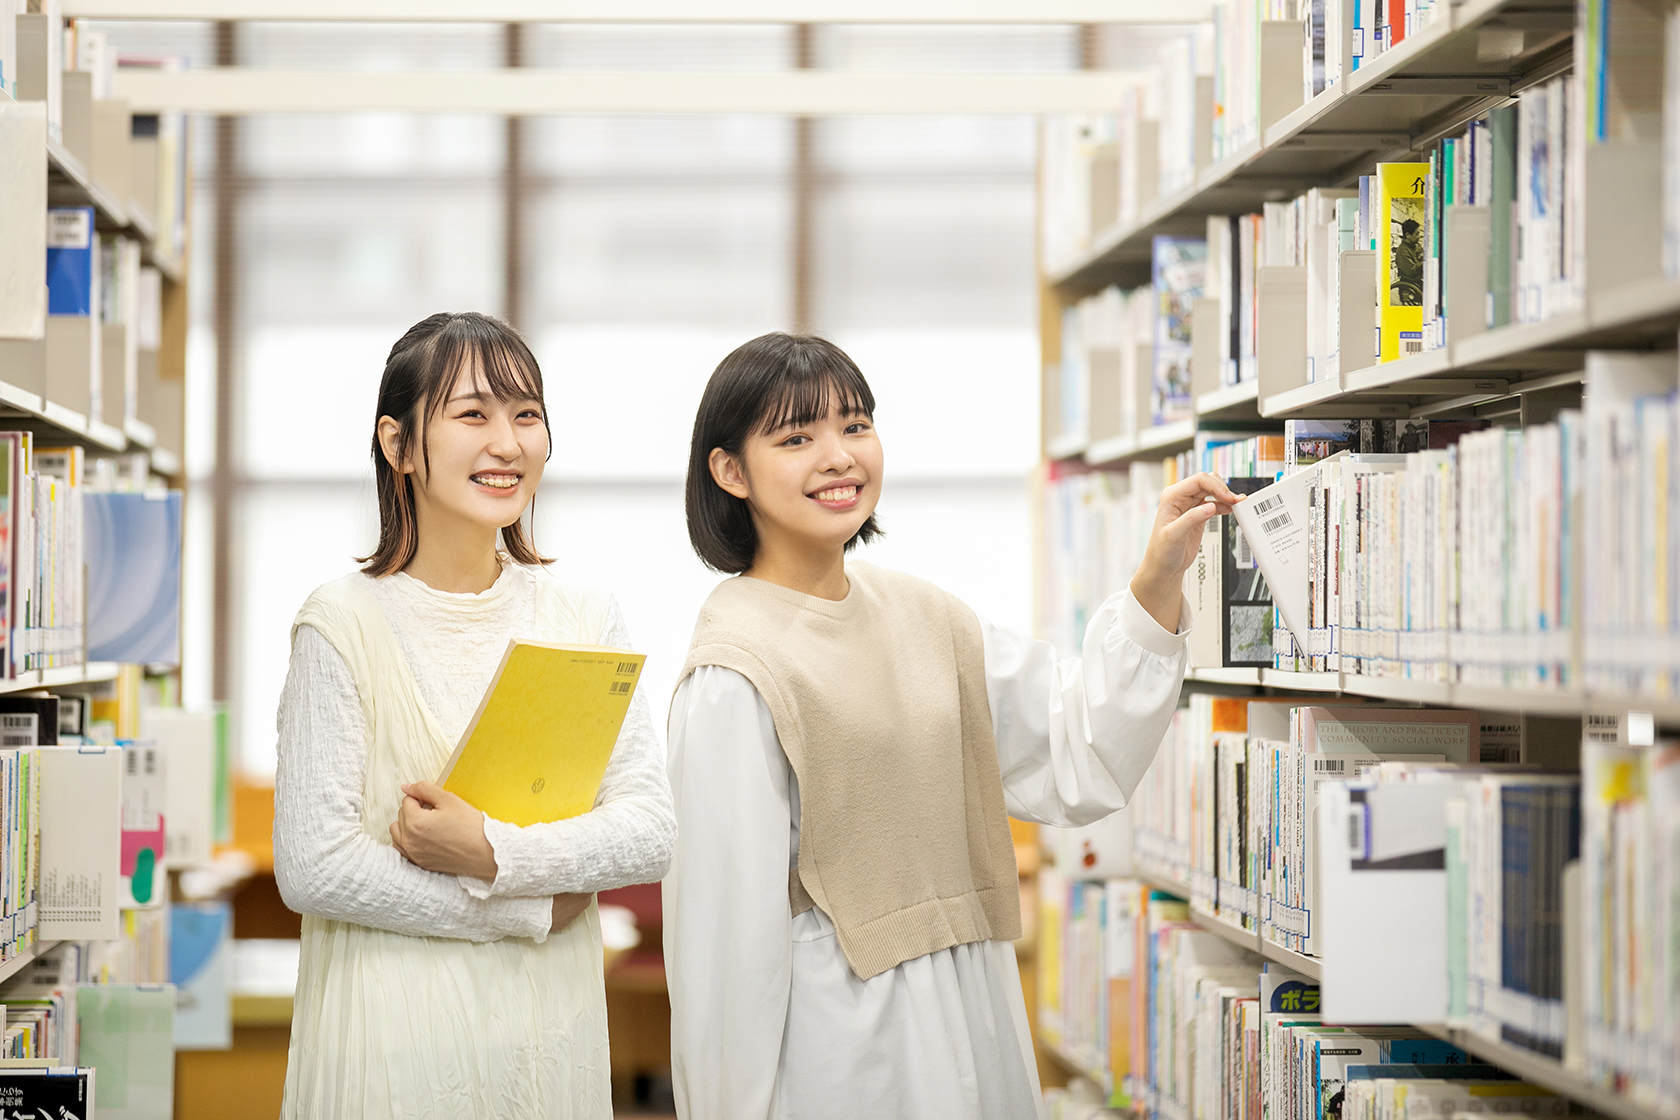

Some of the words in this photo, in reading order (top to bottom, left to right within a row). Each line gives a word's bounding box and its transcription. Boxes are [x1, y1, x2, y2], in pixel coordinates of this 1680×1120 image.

[1320, 725, 1339, 734] THE
[1343, 725, 1379, 735] THEORY
[1382, 726, 1404, 735] AND
[1406, 726, 1451, 735] PRACTICE
[1453, 727, 1467, 735] OF
[1320, 735, 1388, 743] COMMUNITY
[1393, 736, 1430, 744] SOCIAL
[1434, 737, 1466, 745] WORK
[1281, 989, 1320, 1011] ボラ
